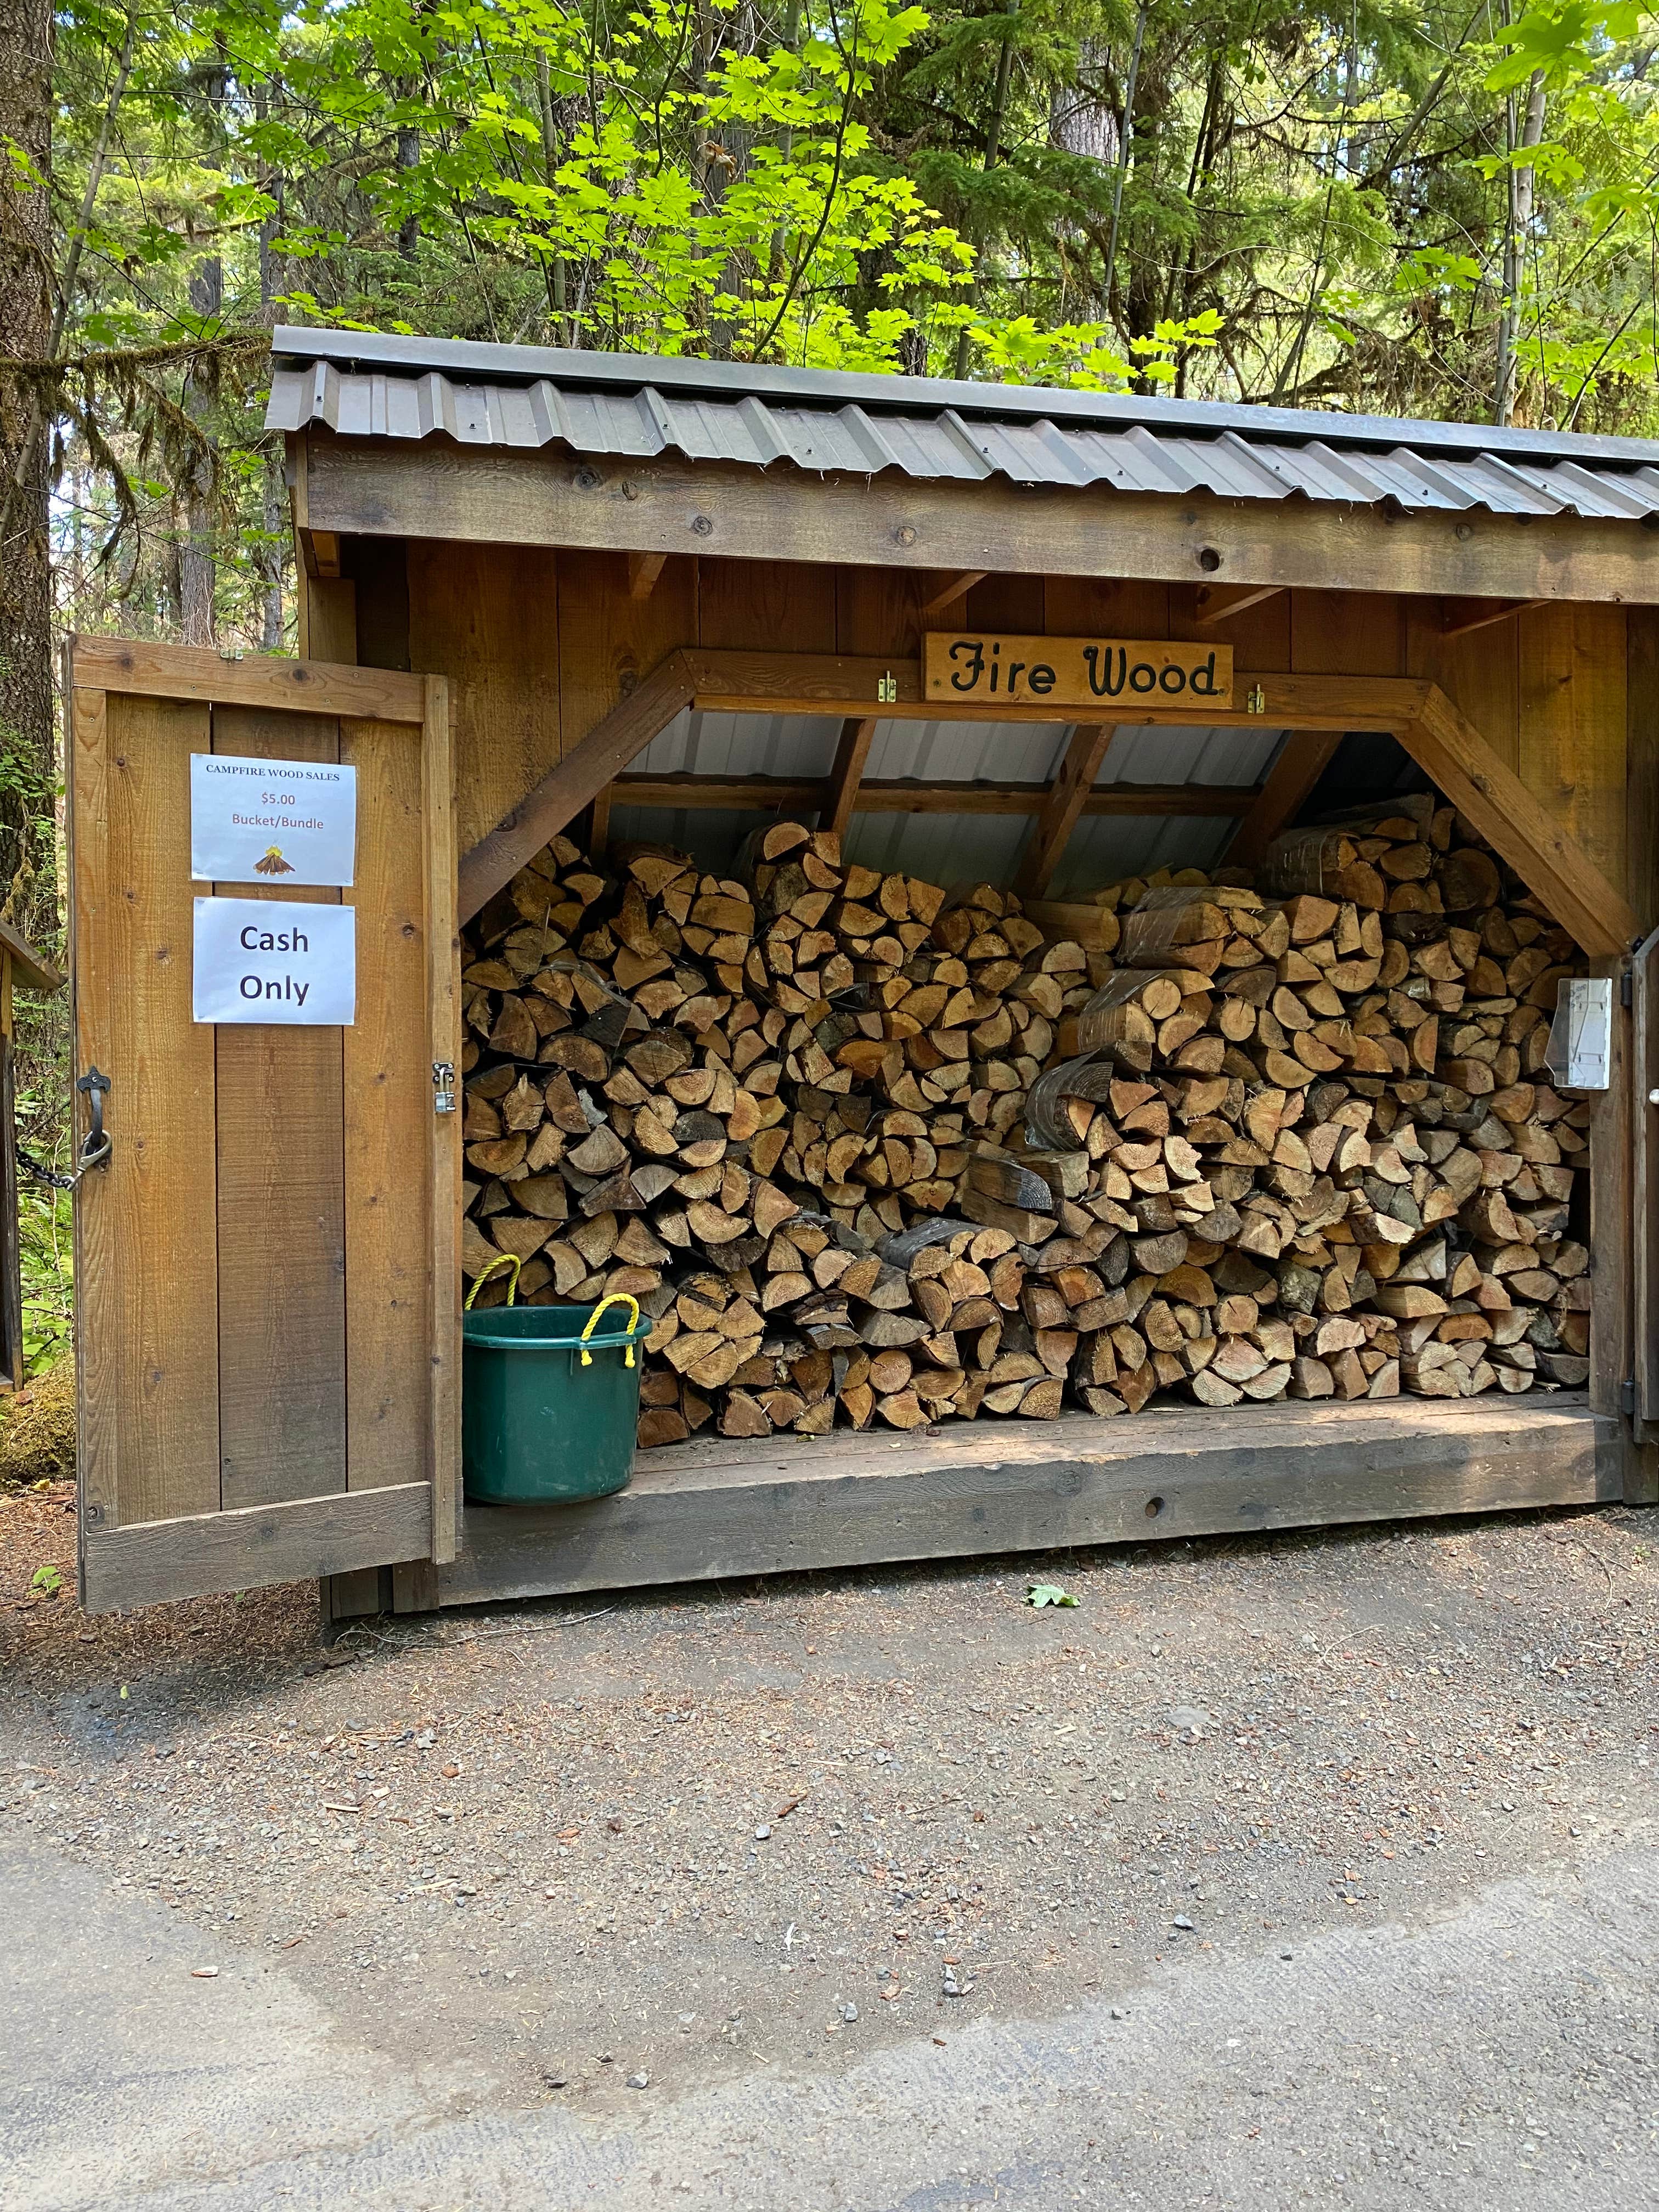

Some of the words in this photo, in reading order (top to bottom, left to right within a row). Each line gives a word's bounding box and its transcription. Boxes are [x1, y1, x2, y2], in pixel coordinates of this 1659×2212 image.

[949, 640, 1057, 694] Fire
[1082, 645, 1218, 697] Wood
[206, 764, 266, 776] CAMPFIRE
[268, 769, 303, 779] WOOD
[306, 771, 340, 782] SALES
[261, 792, 295, 805] $5.00
[232, 814, 324, 829] Bucket/Bundle
[240, 926, 308, 952] Cash
[240, 975, 309, 1006] Only
